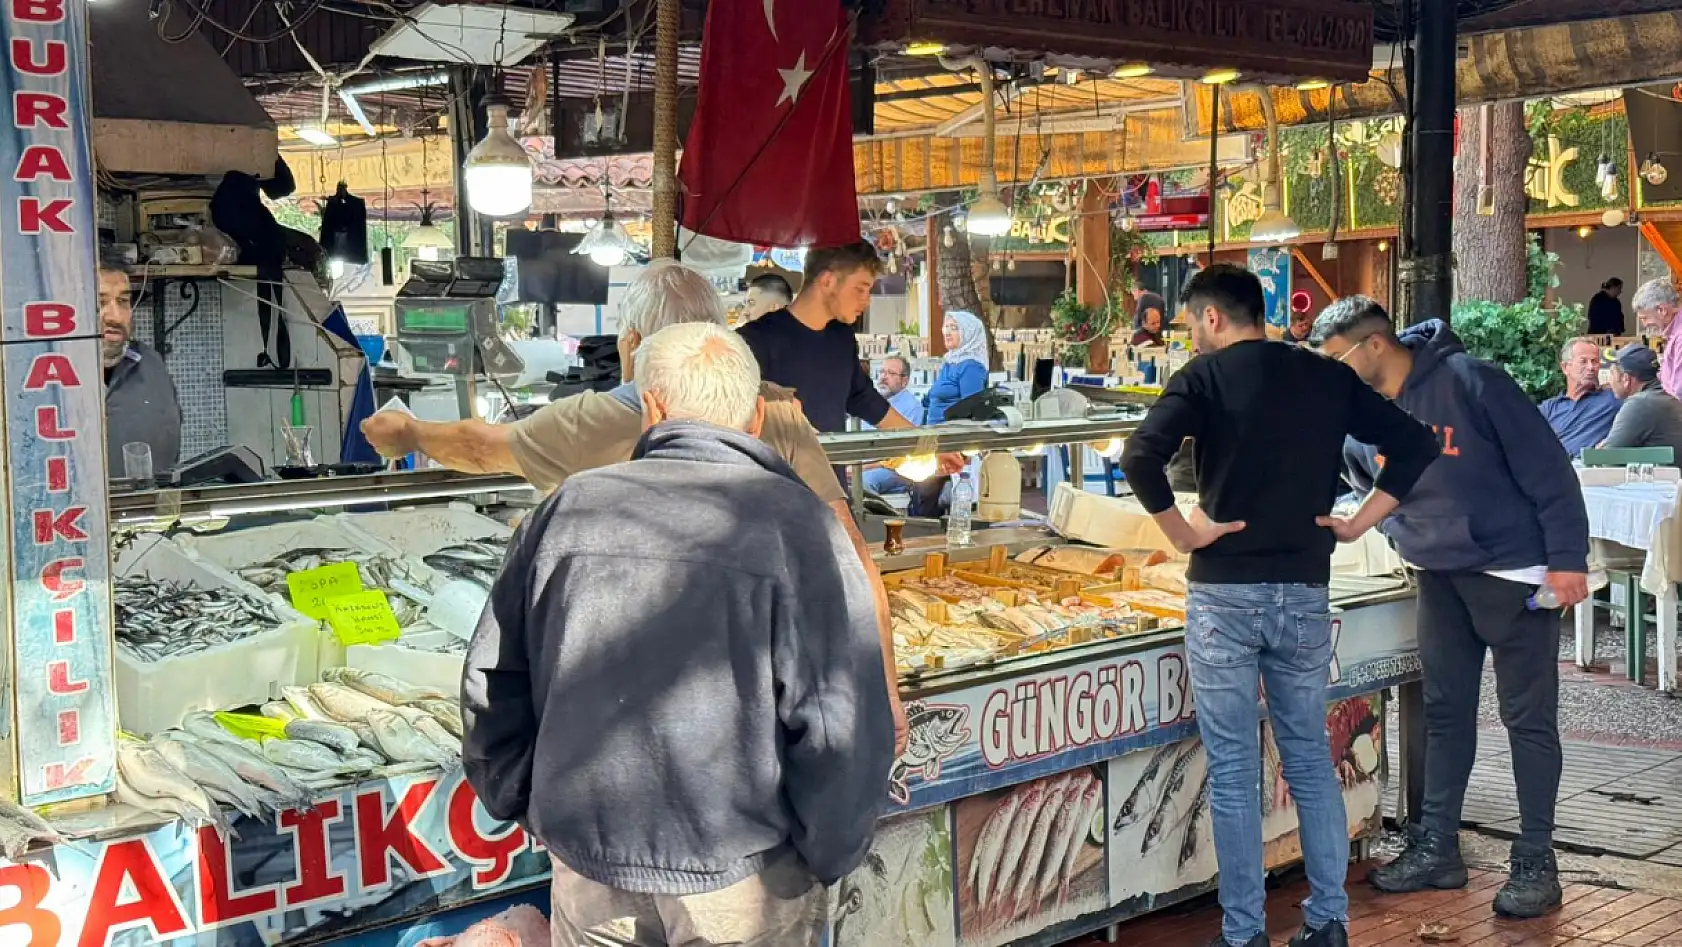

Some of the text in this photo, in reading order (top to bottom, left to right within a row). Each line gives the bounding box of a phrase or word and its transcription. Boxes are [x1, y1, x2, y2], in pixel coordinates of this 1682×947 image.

[12, 0, 76, 235] BURAK
[24, 301, 98, 791] BALIKÇILIK
[980, 661, 1147, 770] GÜNGÖR
[0, 777, 549, 947] BALIKÇ
